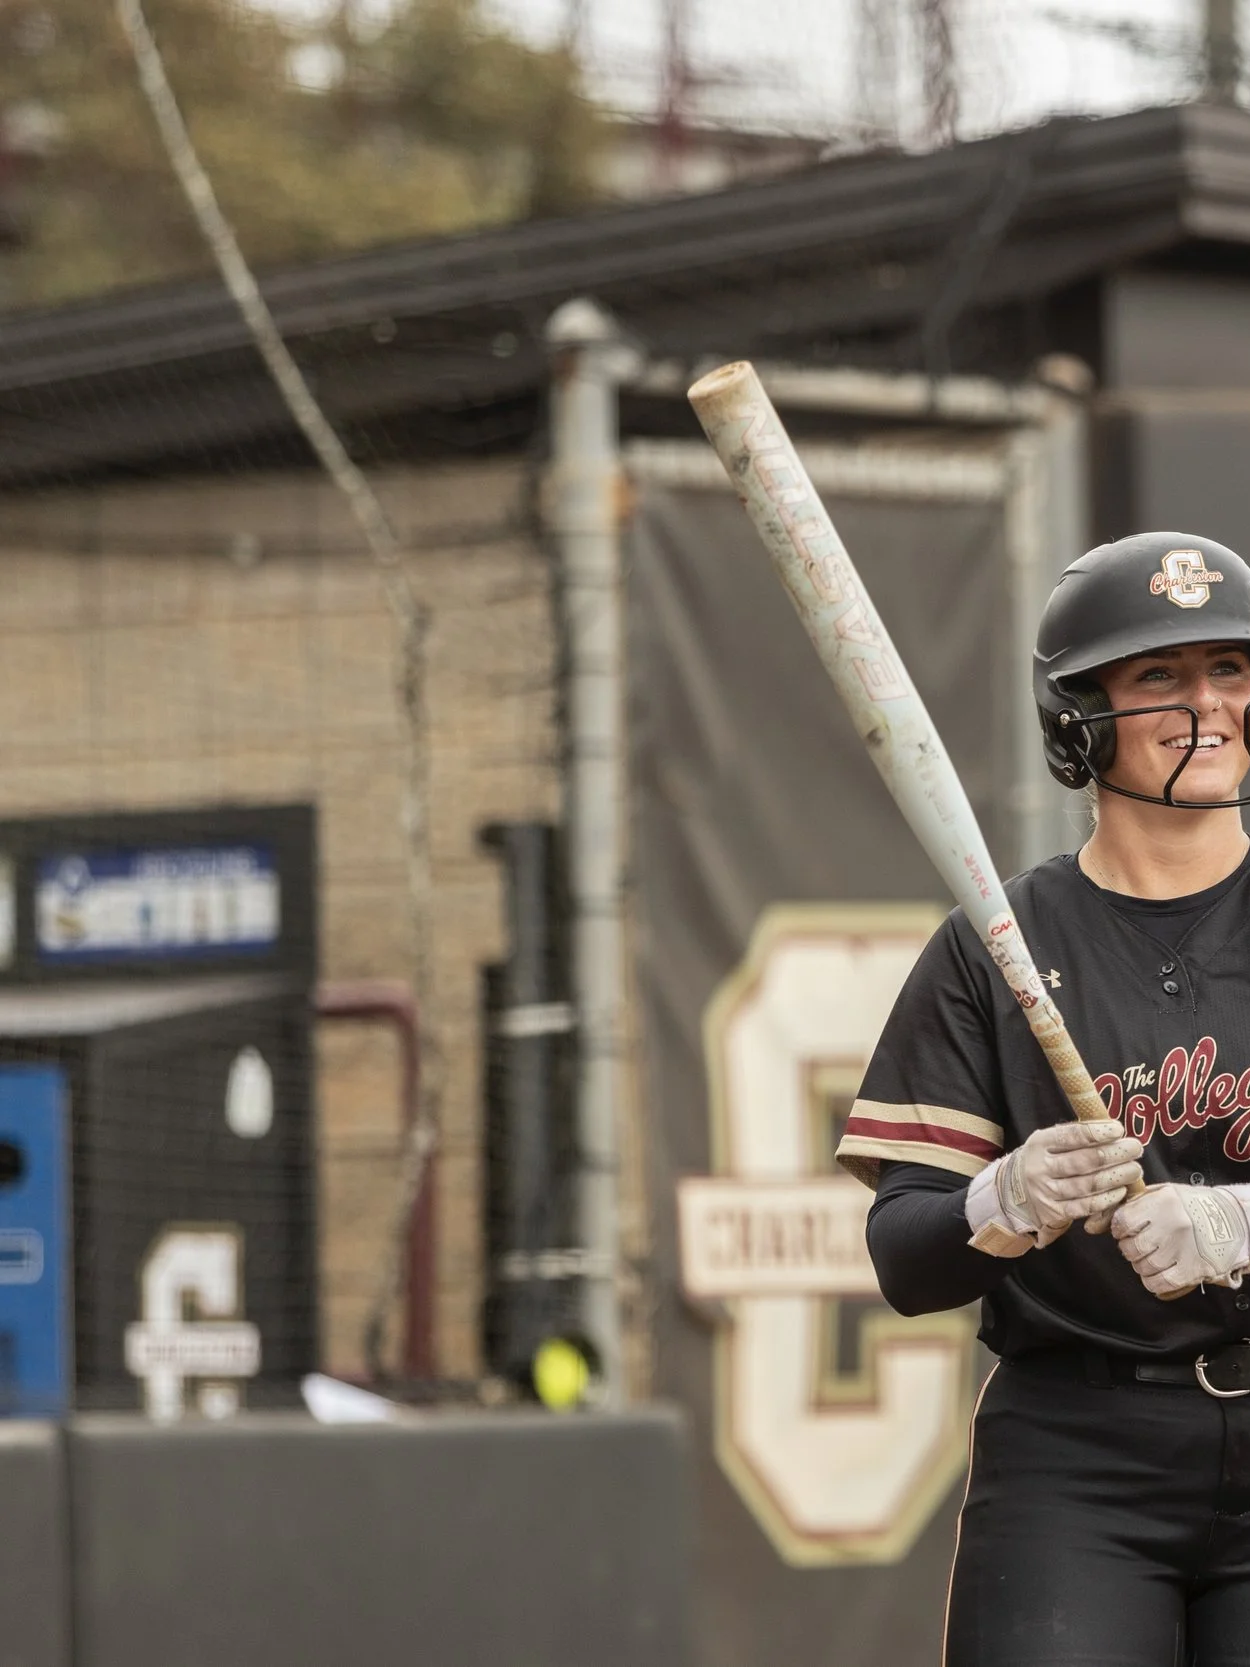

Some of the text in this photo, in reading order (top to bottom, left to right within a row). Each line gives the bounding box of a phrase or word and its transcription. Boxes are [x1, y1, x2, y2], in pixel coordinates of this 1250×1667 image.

[730, 402, 909, 702] EASTON
[1150, 571, 1224, 594] Charleston
[1162, 550, 1210, 608] C
[990, 919, 1013, 936] CAA
[1122, 1062, 1156, 1093] The
